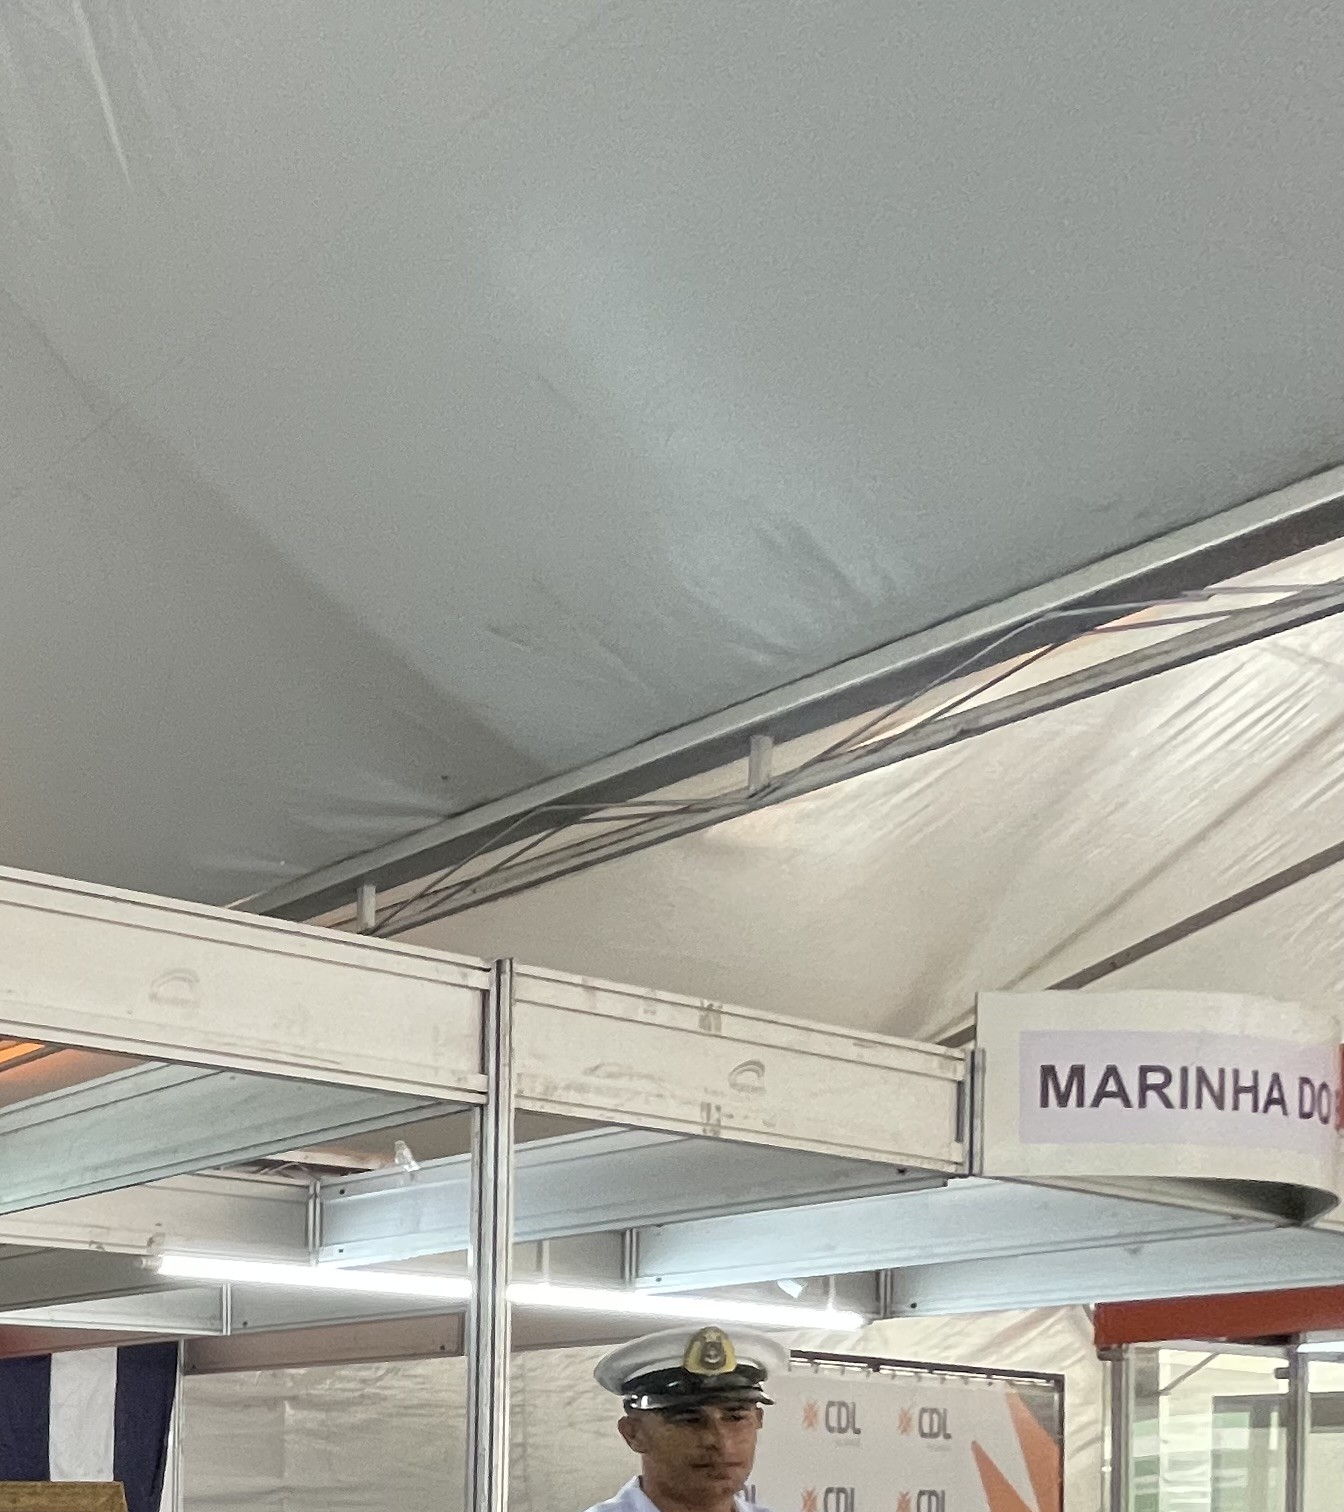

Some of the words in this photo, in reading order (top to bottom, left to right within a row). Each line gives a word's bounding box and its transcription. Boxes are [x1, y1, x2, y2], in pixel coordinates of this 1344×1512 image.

[1039, 1063, 1289, 1117] MARINHA
[1297, 1075, 1332, 1126] DO
[825, 1400, 861, 1435] CDL
[917, 1407, 952, 1439] CDL
